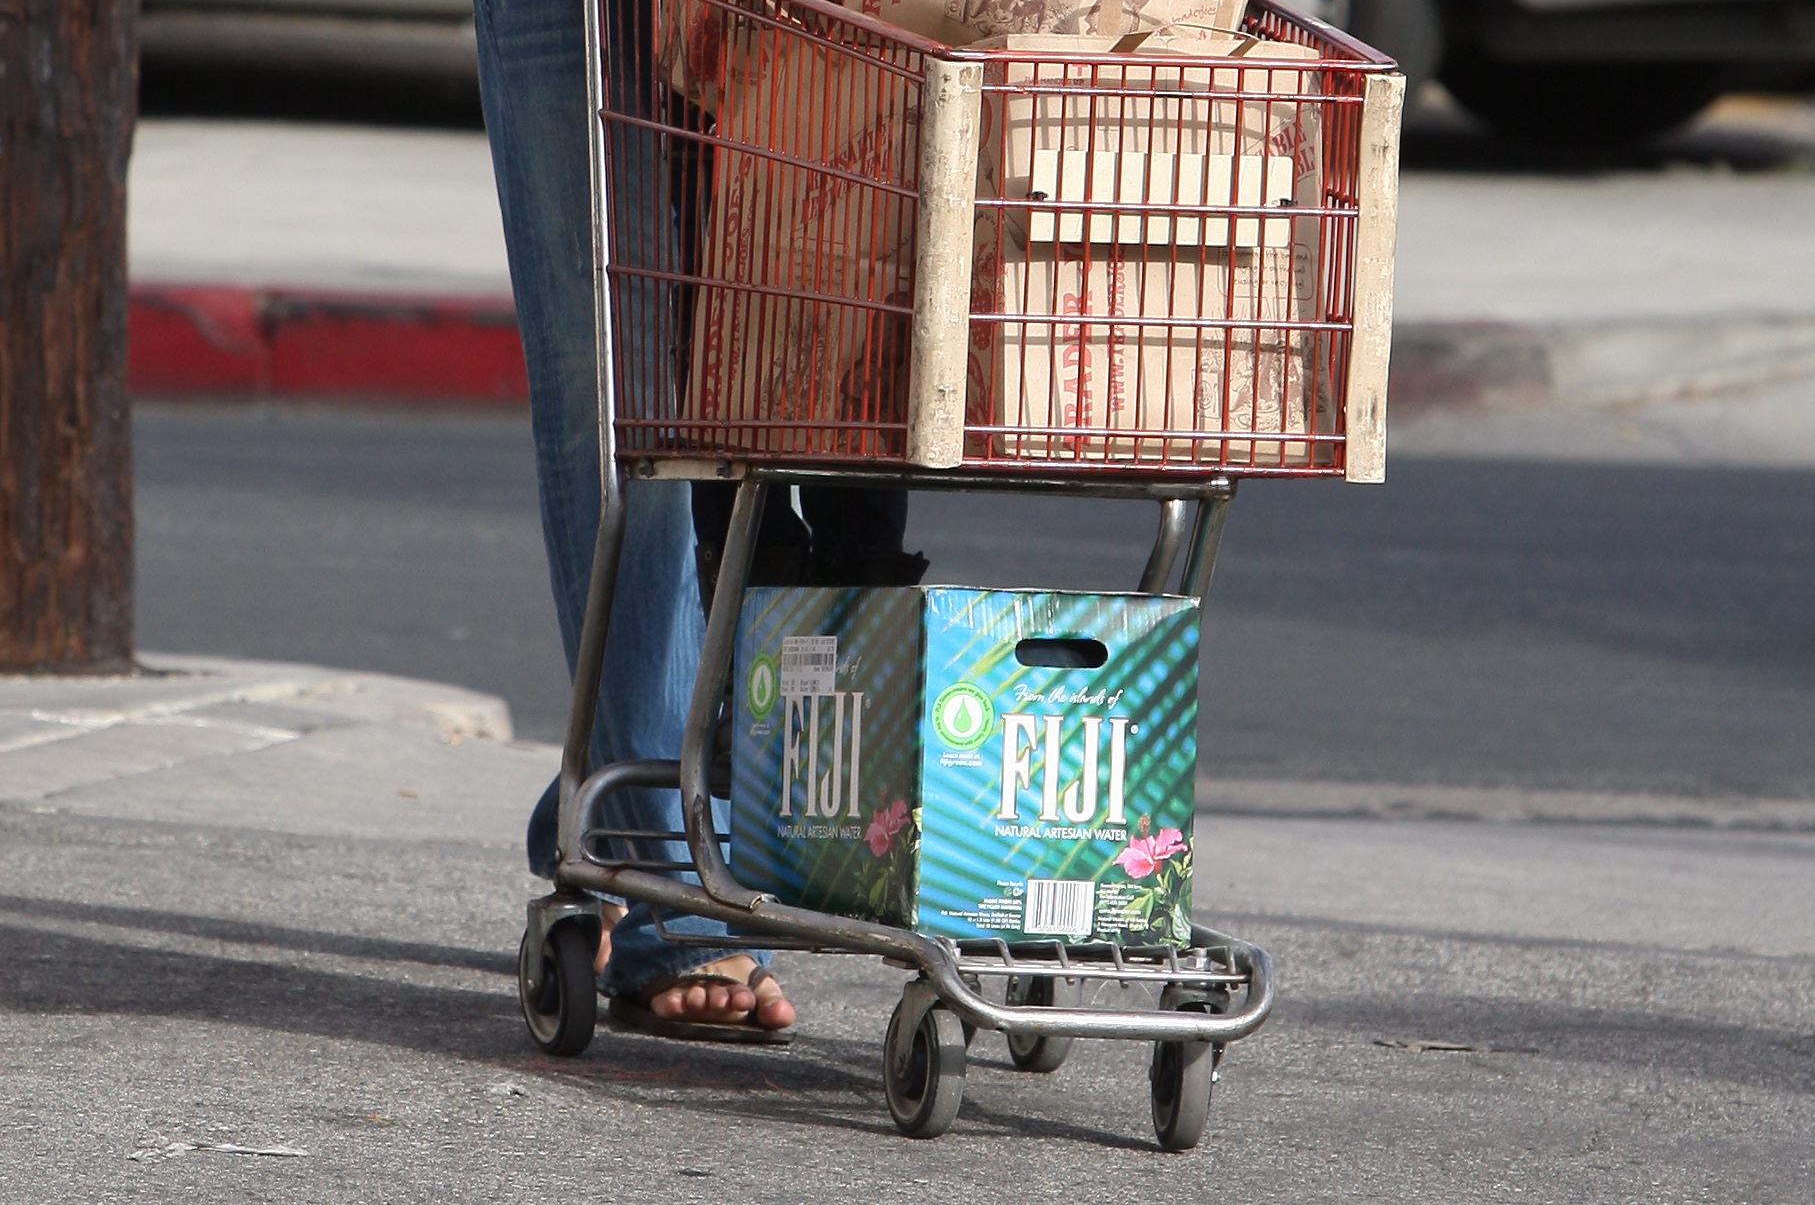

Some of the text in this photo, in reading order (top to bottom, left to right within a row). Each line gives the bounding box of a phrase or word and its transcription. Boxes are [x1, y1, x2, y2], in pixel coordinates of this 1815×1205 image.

[1013, 683, 1124, 710] From the islands of
[779, 691, 864, 817] FIJI
[996, 712, 1130, 825] FIJI
[777, 825, 862, 840] NATURAL ARTESIAN WATER
[994, 825, 1128, 842] NATURAL ARTESIAN WATER
